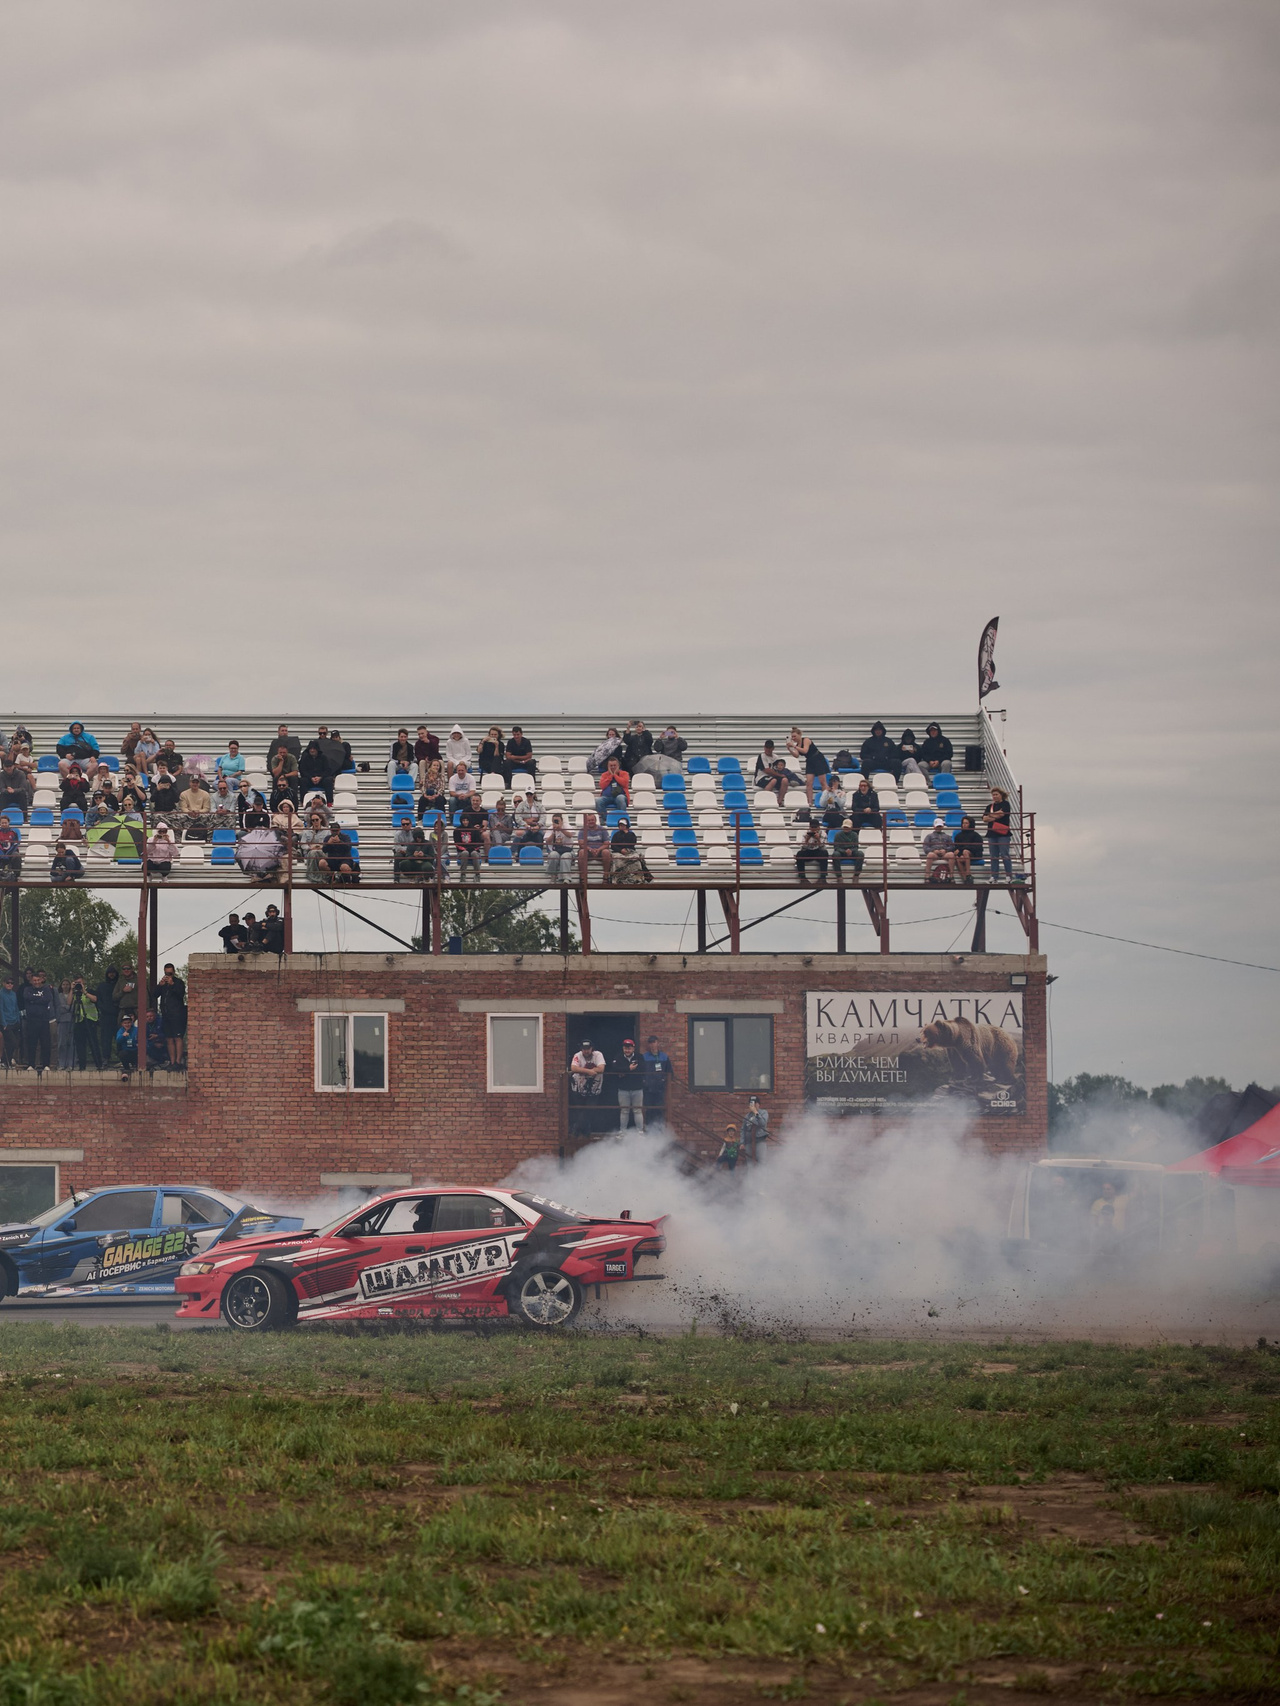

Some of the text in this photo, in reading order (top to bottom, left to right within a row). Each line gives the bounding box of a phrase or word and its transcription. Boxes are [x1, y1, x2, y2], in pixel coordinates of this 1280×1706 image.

[816, 998, 1022, 1028] КАМЧАТКА
[815, 1033, 900, 1044] КВАРТАЛ
[816, 1056, 900, 1070] БЛИЖЕ, ЧЕМ
[816, 1070, 908, 1083] ВЫ ДУМАЕТЕ!
[990, 1100, 1017, 1108] СОЮЗ
[103, 1235, 163, 1268] GARAGE
[163, 1231, 186, 1255] 22
[363, 1244, 504, 1294] ШАМПУР
[605, 1263, 626, 1272] TARGET
